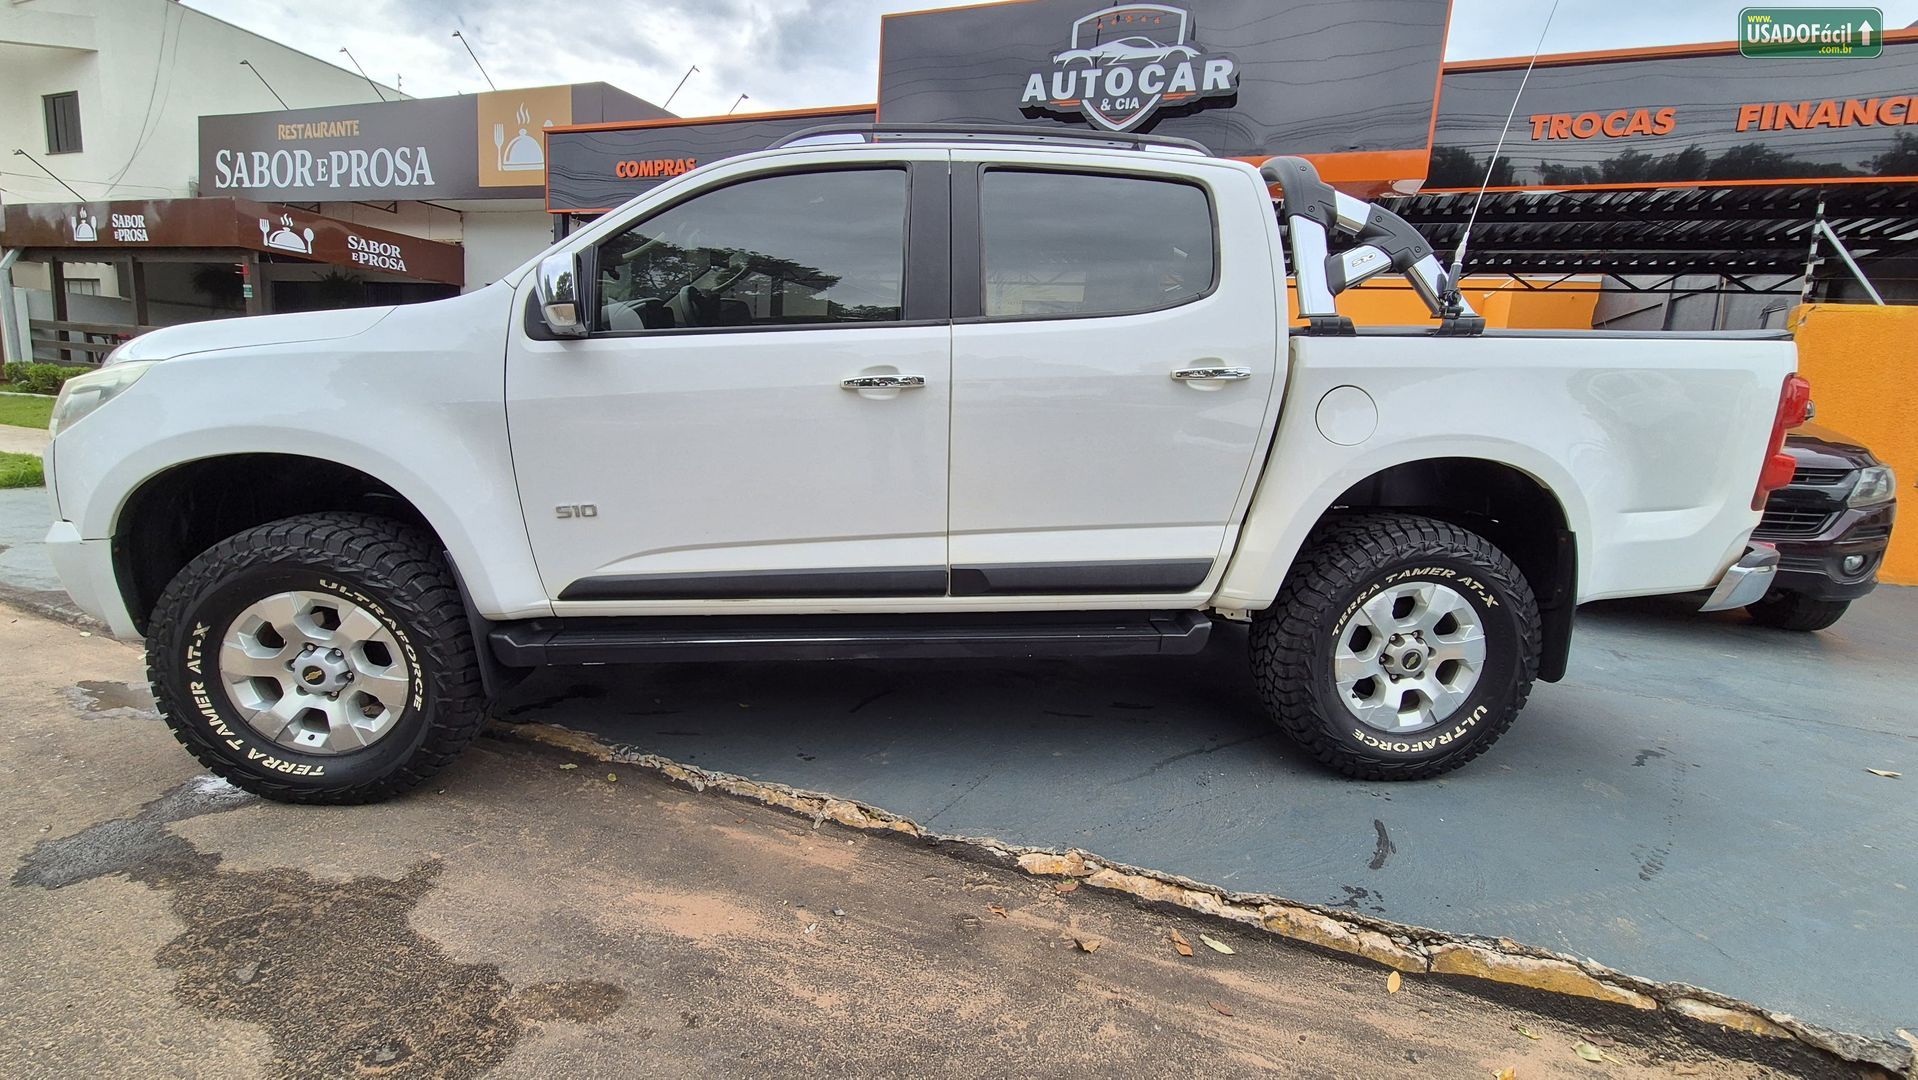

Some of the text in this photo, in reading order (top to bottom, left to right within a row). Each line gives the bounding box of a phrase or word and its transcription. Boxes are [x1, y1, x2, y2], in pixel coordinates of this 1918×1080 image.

[1021, 59, 1234, 102] AUTOCAR
[1100, 97, 1140, 111] & CIA
[1735, 95, 1918, 132] FINANCI
[277, 120, 360, 140] RESTAURANTE
[1529, 107, 1678, 140] TROCAS
[215, 149, 315, 189] SABOR
[329, 147, 436, 188] PROSA
[112, 213, 146, 229] SABOR
[347, 235, 402, 259] SABOR
[358, 251, 407, 272] PROSA
[555, 504, 598, 519] S10
[1331, 567, 1500, 637] TERRA TAMER AT-X
[319, 579, 423, 712] ULTRAFORCE
[187, 621, 325, 777] TERRA TAMER AT-X
[1352, 705, 1488, 752] ULTRAFORCE
